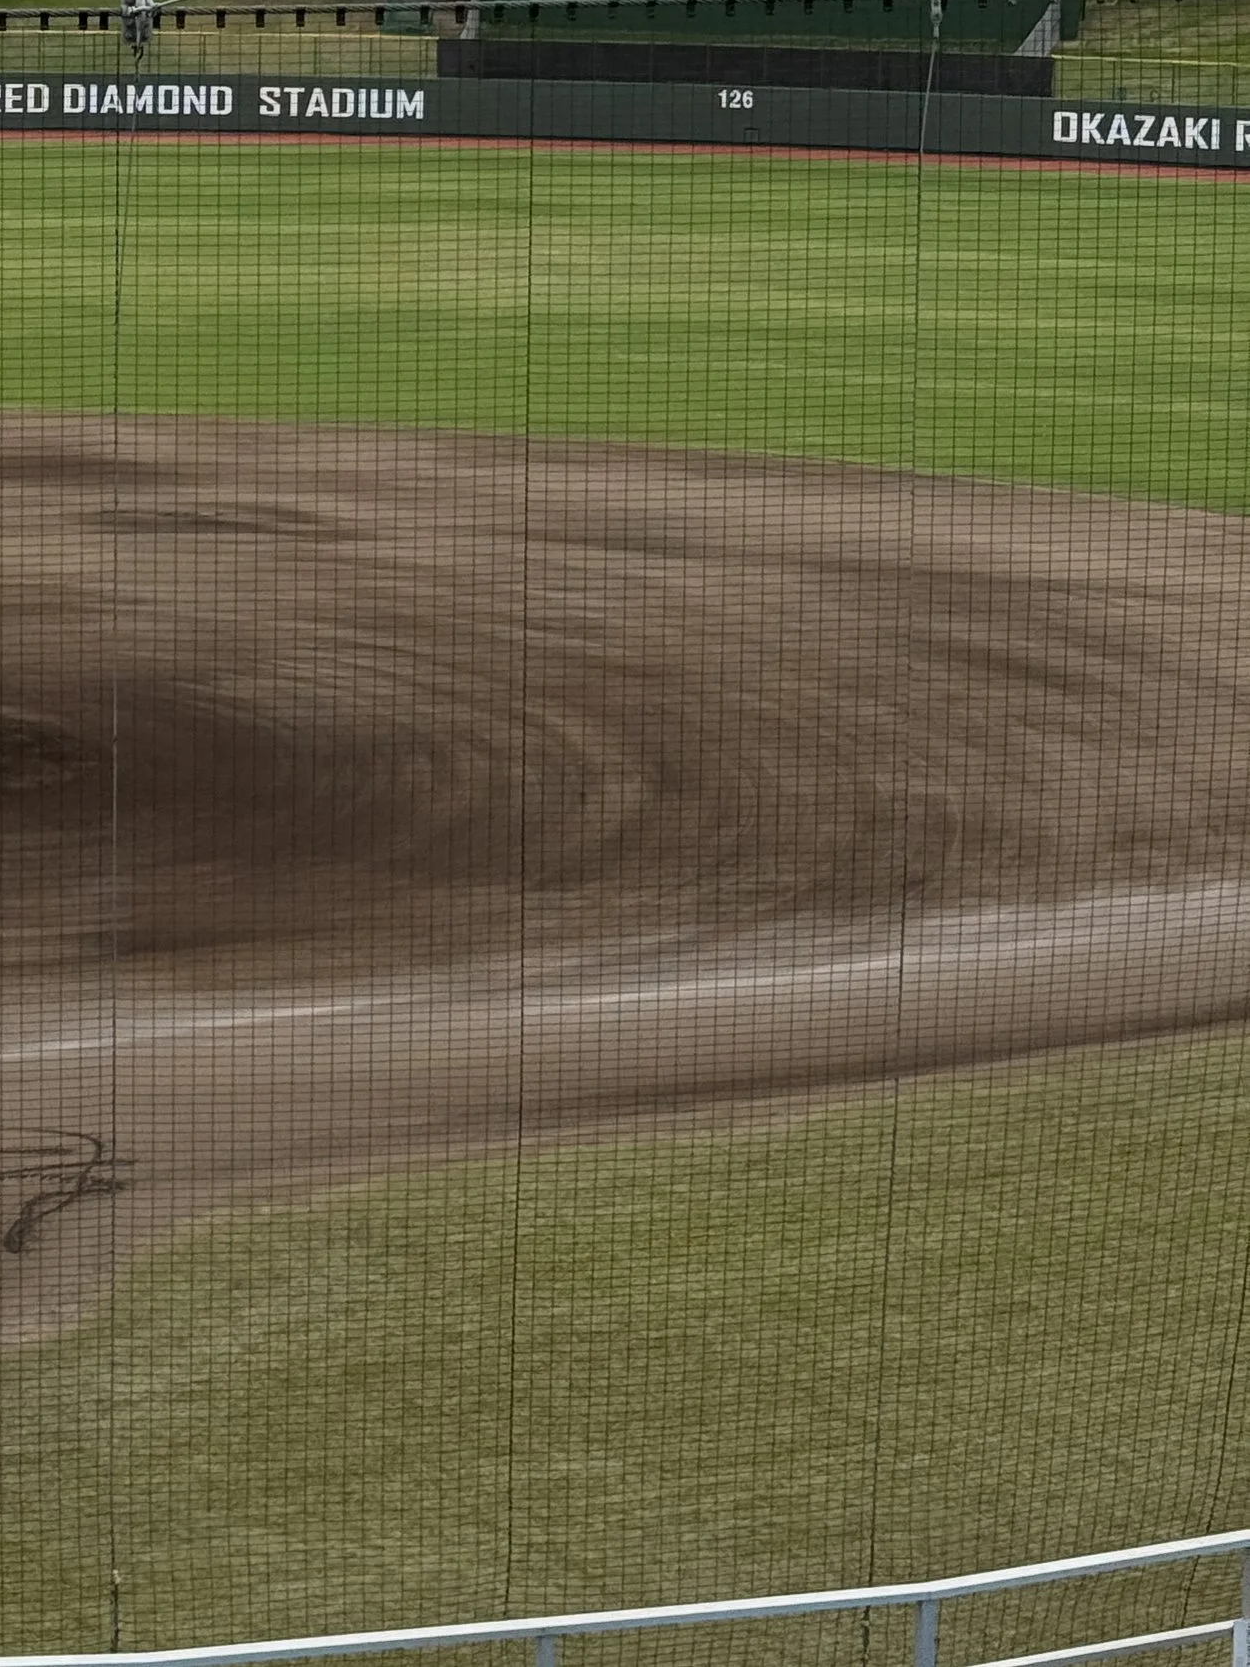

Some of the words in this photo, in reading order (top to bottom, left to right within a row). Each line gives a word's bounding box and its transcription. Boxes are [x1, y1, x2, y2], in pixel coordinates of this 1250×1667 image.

[63, 83, 233, 116] DIAMOND
[259, 86, 425, 121] STADIUM
[717, 89, 754, 109] 126
[1053, 111, 1221, 151] OKAZAKI
